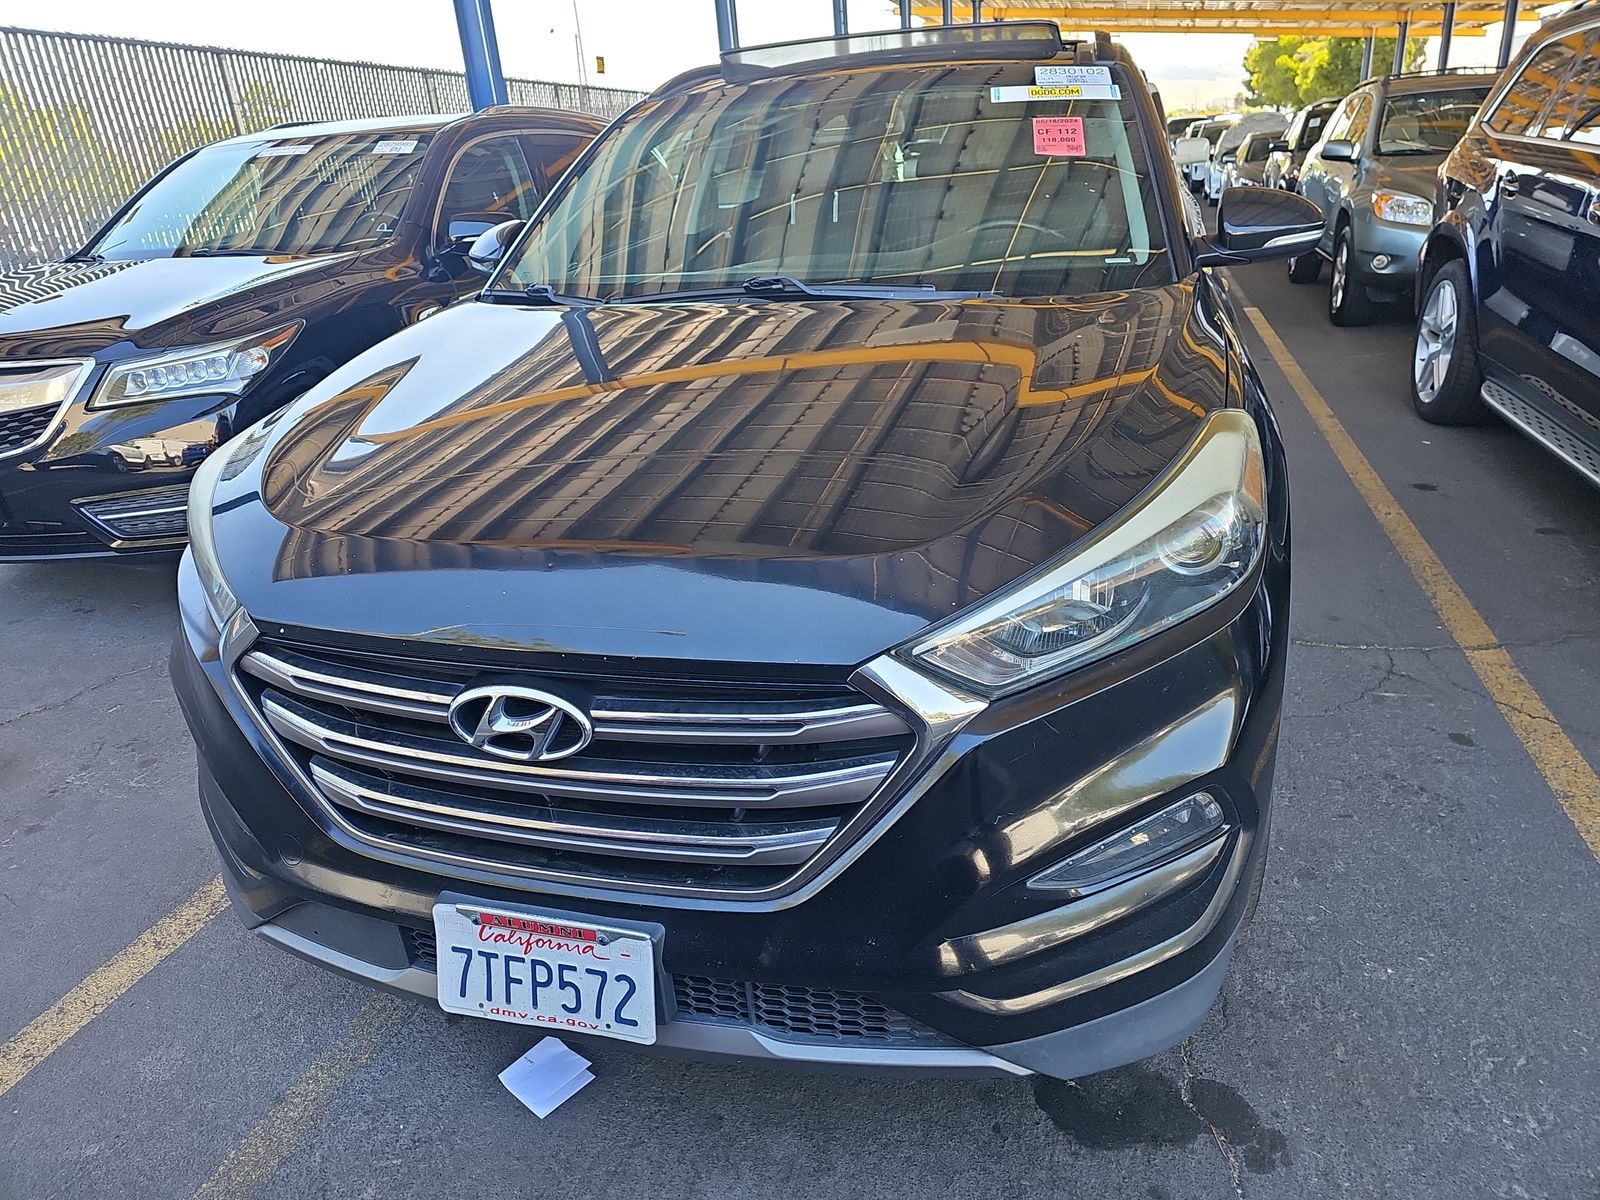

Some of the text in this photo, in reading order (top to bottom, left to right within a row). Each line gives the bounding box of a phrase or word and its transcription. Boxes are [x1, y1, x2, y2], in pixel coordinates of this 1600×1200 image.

[1039, 67, 1104, 75] 2830102
[1030, 88, 1080, 96] DGDG.COM
[1057, 127, 1077, 135] 112
[491, 916, 585, 939] ALUMNI
[478, 925, 610, 960] California
[451, 946, 638, 1026] 7TFP572
[490, 1007, 599, 1031] dmv.ca.gov
